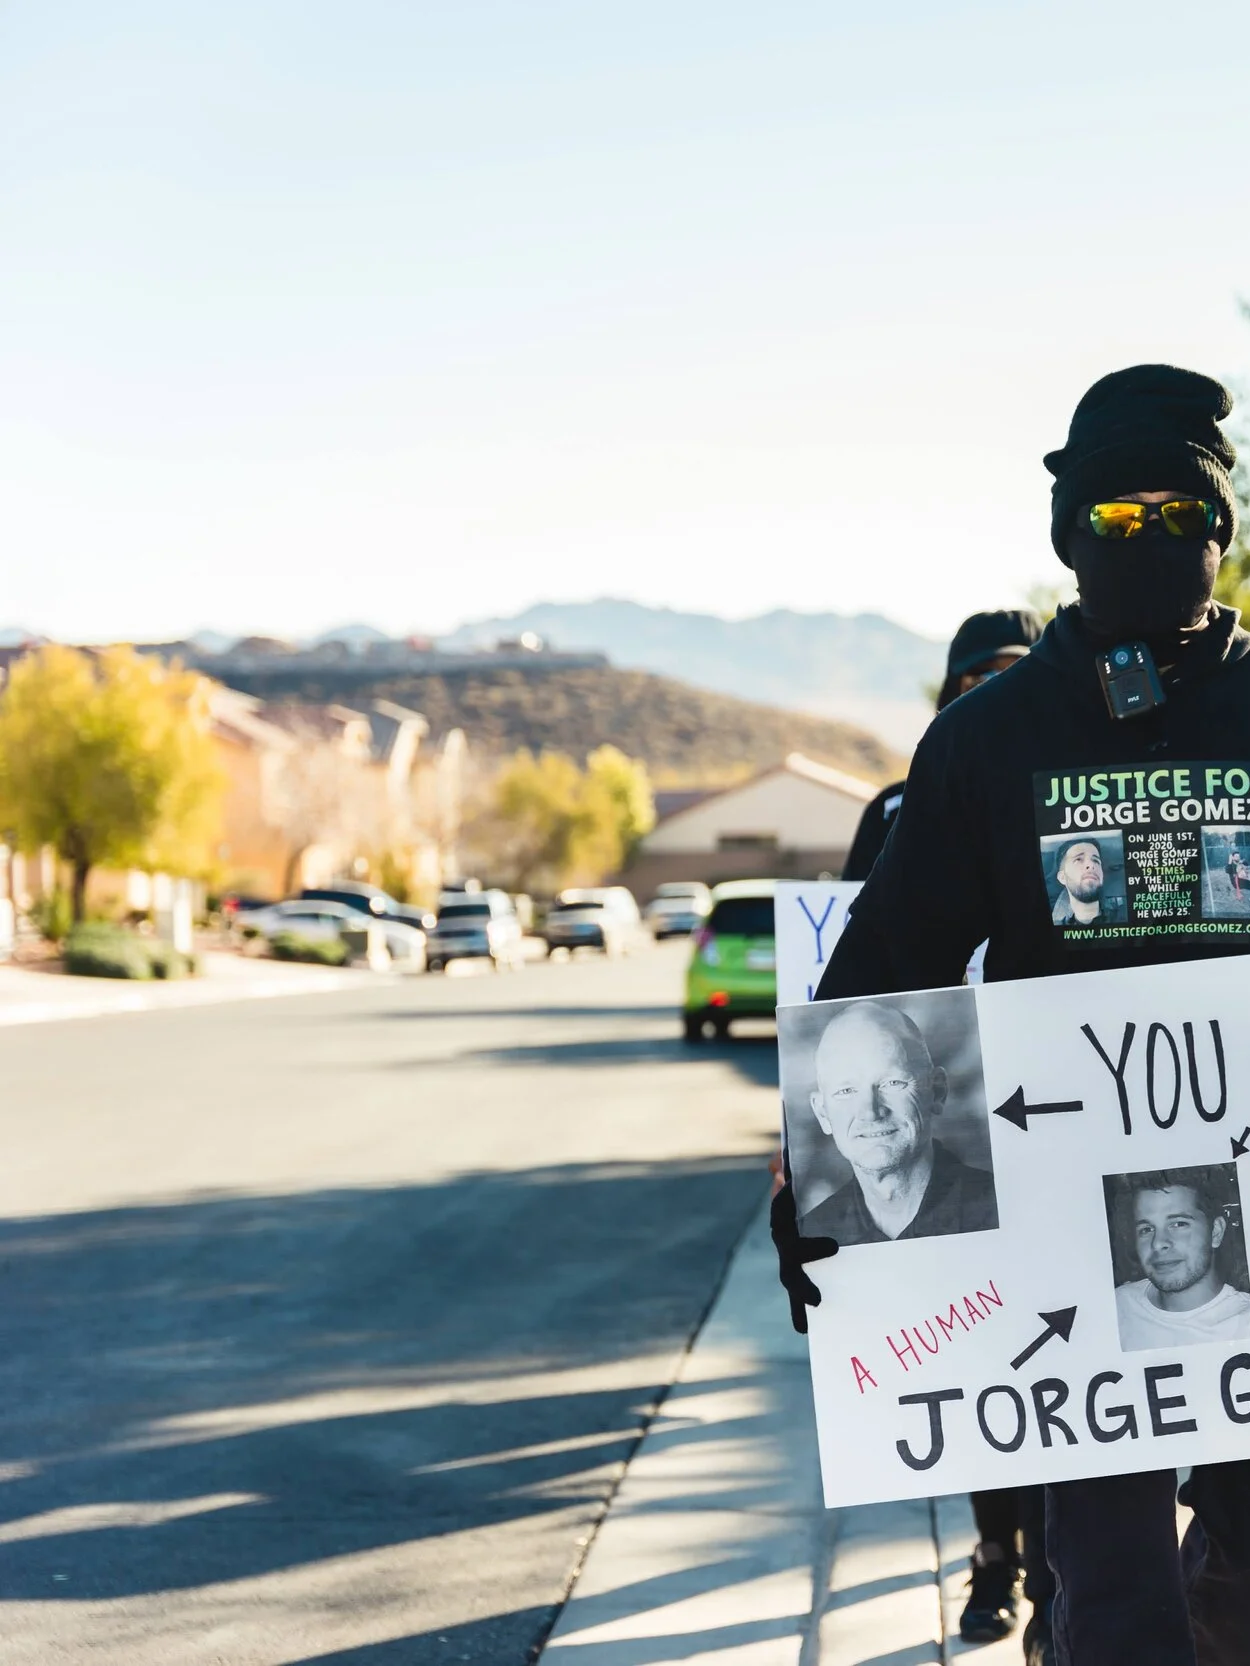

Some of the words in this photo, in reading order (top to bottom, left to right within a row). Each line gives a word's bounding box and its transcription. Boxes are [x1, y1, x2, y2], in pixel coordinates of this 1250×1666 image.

[1045, 769, 1192, 807] JUSTICE
[1060, 801, 1151, 829] JORGE
[1128, 834, 1144, 843] ON
[1147, 832, 1173, 842] JUNE
[1176, 832, 1196, 841] 1ST,
[1149, 841, 1175, 851] 2020,
[1127, 850, 1159, 860] JORGE
[1161, 848, 1198, 859] GOMEZ
[1137, 858, 1159, 868] WAS
[1161, 857, 1189, 867] SHOT
[1141, 867, 1153, 876] 19
[1155, 866, 1185, 875] TIMES
[1128, 876, 1140, 886] BY
[1143, 875, 1162, 885] THE
[1164, 874, 1199, 883] LVMPD
[1147, 883, 1180, 892] WHILE
[1135, 890, 1192, 902] PEACEFULLY
[1132, 898, 1195, 911] PROTESTING.
[1137, 909, 1149, 918] HE
[1151, 908, 1174, 918] WAS
[1176, 907, 1191, 916] 25.
[1080, 1019, 1227, 1135] YOU
[850, 1356, 878, 1393] A
[886, 1279, 1004, 1371] HUMAN
[896, 1364, 1198, 1471] JORGE
